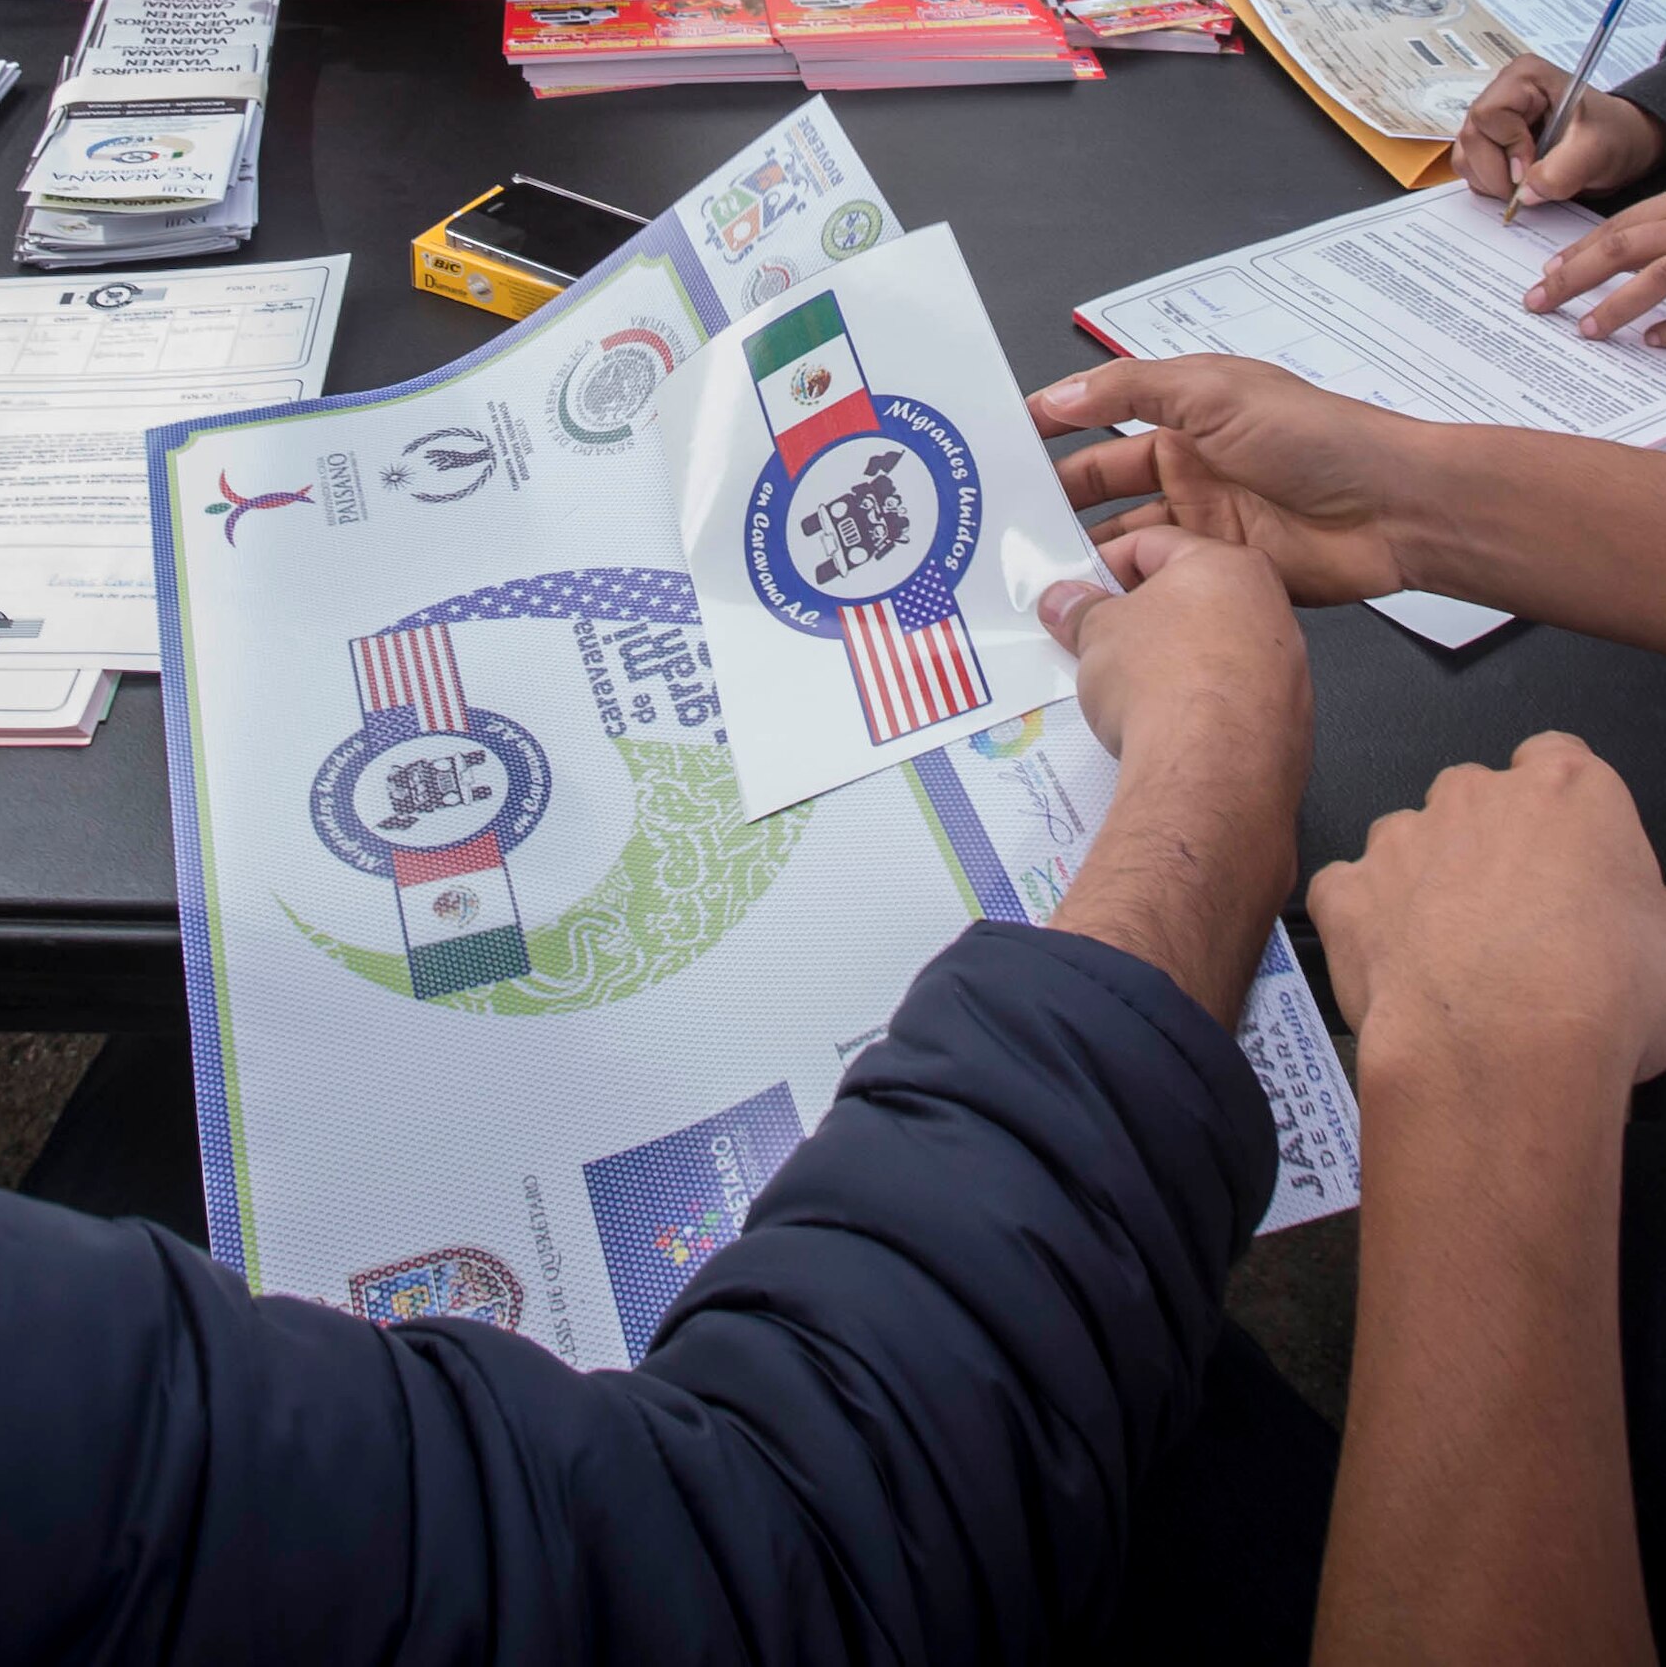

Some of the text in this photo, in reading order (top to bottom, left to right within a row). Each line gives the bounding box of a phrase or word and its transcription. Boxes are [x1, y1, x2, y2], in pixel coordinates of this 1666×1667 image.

[114, 17, 189, 27] SEGUROS
[92, 67, 170, 75] SEGUROS
[52, 171, 213, 182] IX CARAVANA
[798, 116, 844, 187] RIOVERDE
[498, 401, 530, 481] DERECHOS HUMANOS
[572, 439, 635, 456] SENADO
[327, 452, 361, 525] PAISANO
[884, 400, 977, 571] Migrantes Unidos
[751, 481, 820, 628] en Caravana A.C.
[573, 619, 627, 738] caravana
[602, 622, 664, 724] de mi
[653, 627, 721, 727] gran
[316, 740, 383, 870] Migrantes Unidos
[518, 739, 543, 812] Caravana
[1268, 1021, 1315, 1116] SERRA
[1279, 991, 1321, 1081] Orgullo
[1309, 1128, 1336, 1168] DE
